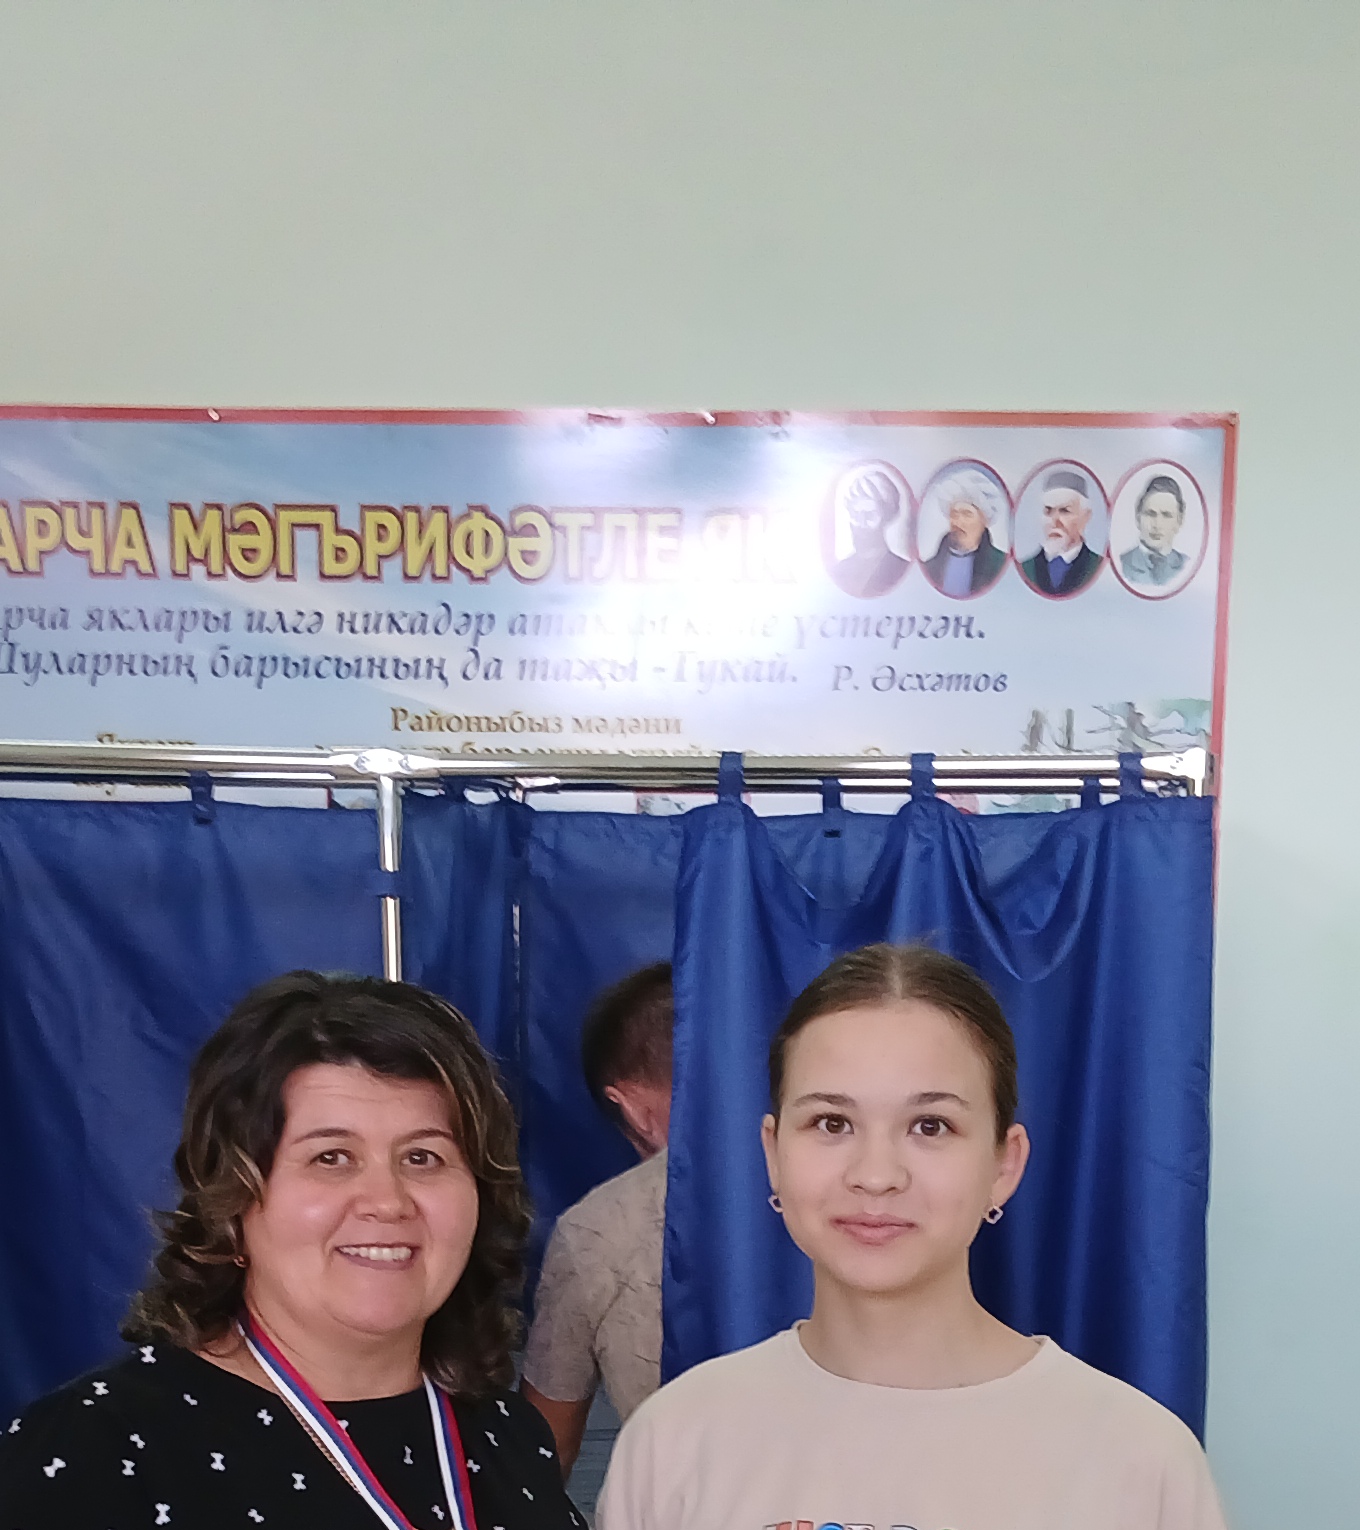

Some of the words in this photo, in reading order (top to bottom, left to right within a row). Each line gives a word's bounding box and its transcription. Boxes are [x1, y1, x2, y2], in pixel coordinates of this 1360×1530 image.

[167, 500, 683, 586] МӘГЪРИФӘТЛЕ
[81, 603, 232, 643] яклары
[244, 605, 324, 637] илгә
[335, 599, 496, 643] никадәр
[794, 612, 986, 650] үстергән.
[209, 644, 449, 689] барысының
[460, 647, 503, 682] да
[517, 656, 639, 691] таҗы
[831, 669, 861, 692] Р.
[871, 664, 1008, 694] Әсхәтов
[390, 706, 563, 734] Районыбыз
[571, 714, 683, 739] мәдәни
